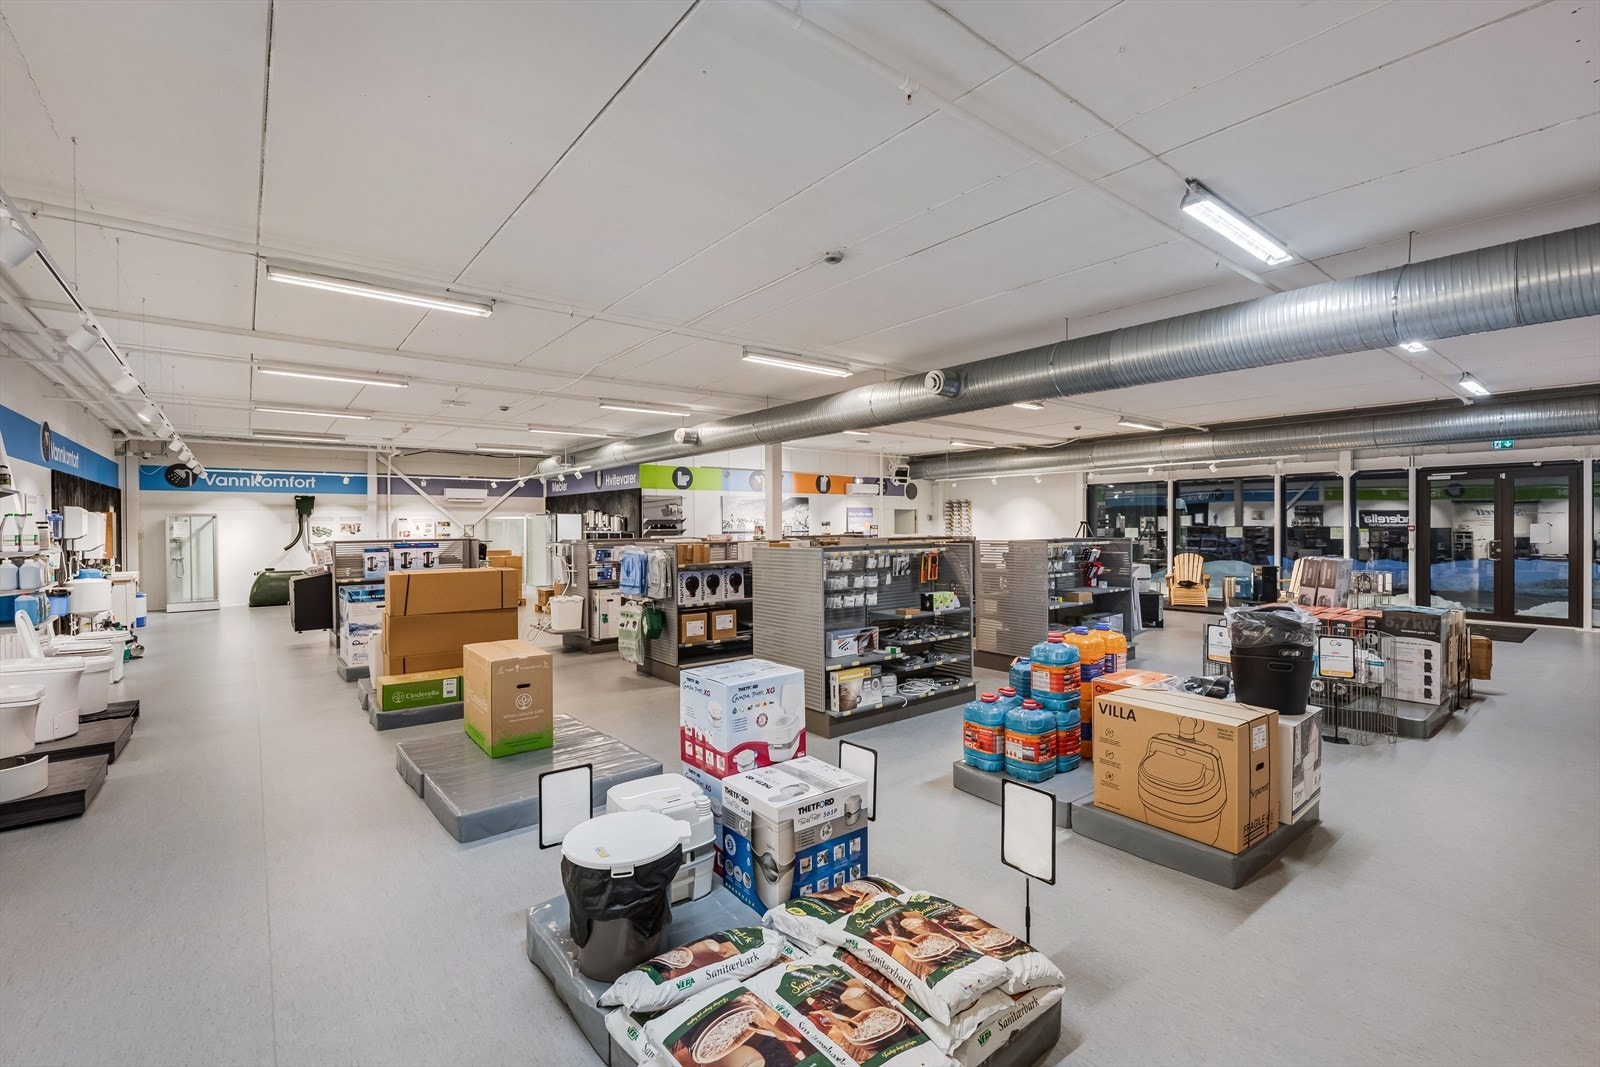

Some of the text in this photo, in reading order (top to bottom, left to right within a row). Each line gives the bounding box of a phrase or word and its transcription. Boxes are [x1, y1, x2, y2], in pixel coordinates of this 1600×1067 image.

[51, 441, 80, 469] Vannkomfort
[205, 473, 316, 489] Vannkomfort
[605, 472, 637, 487] Hvitevarer
[1385, 616, 1409, 630] 5,7
[1412, 615, 1438, 631] kW
[686, 677, 700, 685] THETFRD
[738, 684, 759, 692] THETFRD
[406, 689, 440, 699] Cinderella
[703, 688, 711, 697] XG
[766, 686, 775, 695] XG
[1098, 702, 1137, 722] VILLA
[724, 786, 750, 805] THETFORD
[797, 797, 835, 815] THETFORD
[823, 807, 838, 818] 565P
[1243, 813, 1265, 835] FRAGILE
[705, 952, 760, 980] Sanitærbark
[866, 948, 914, 991] Sanitærbark
[676, 977, 696, 990] VERA
[775, 1003, 791, 1019] VERA
[997, 996, 1040, 1032] Sanitærbark
[627, 1026, 640, 1042] VERA
[977, 1029, 992, 1046] VERA
